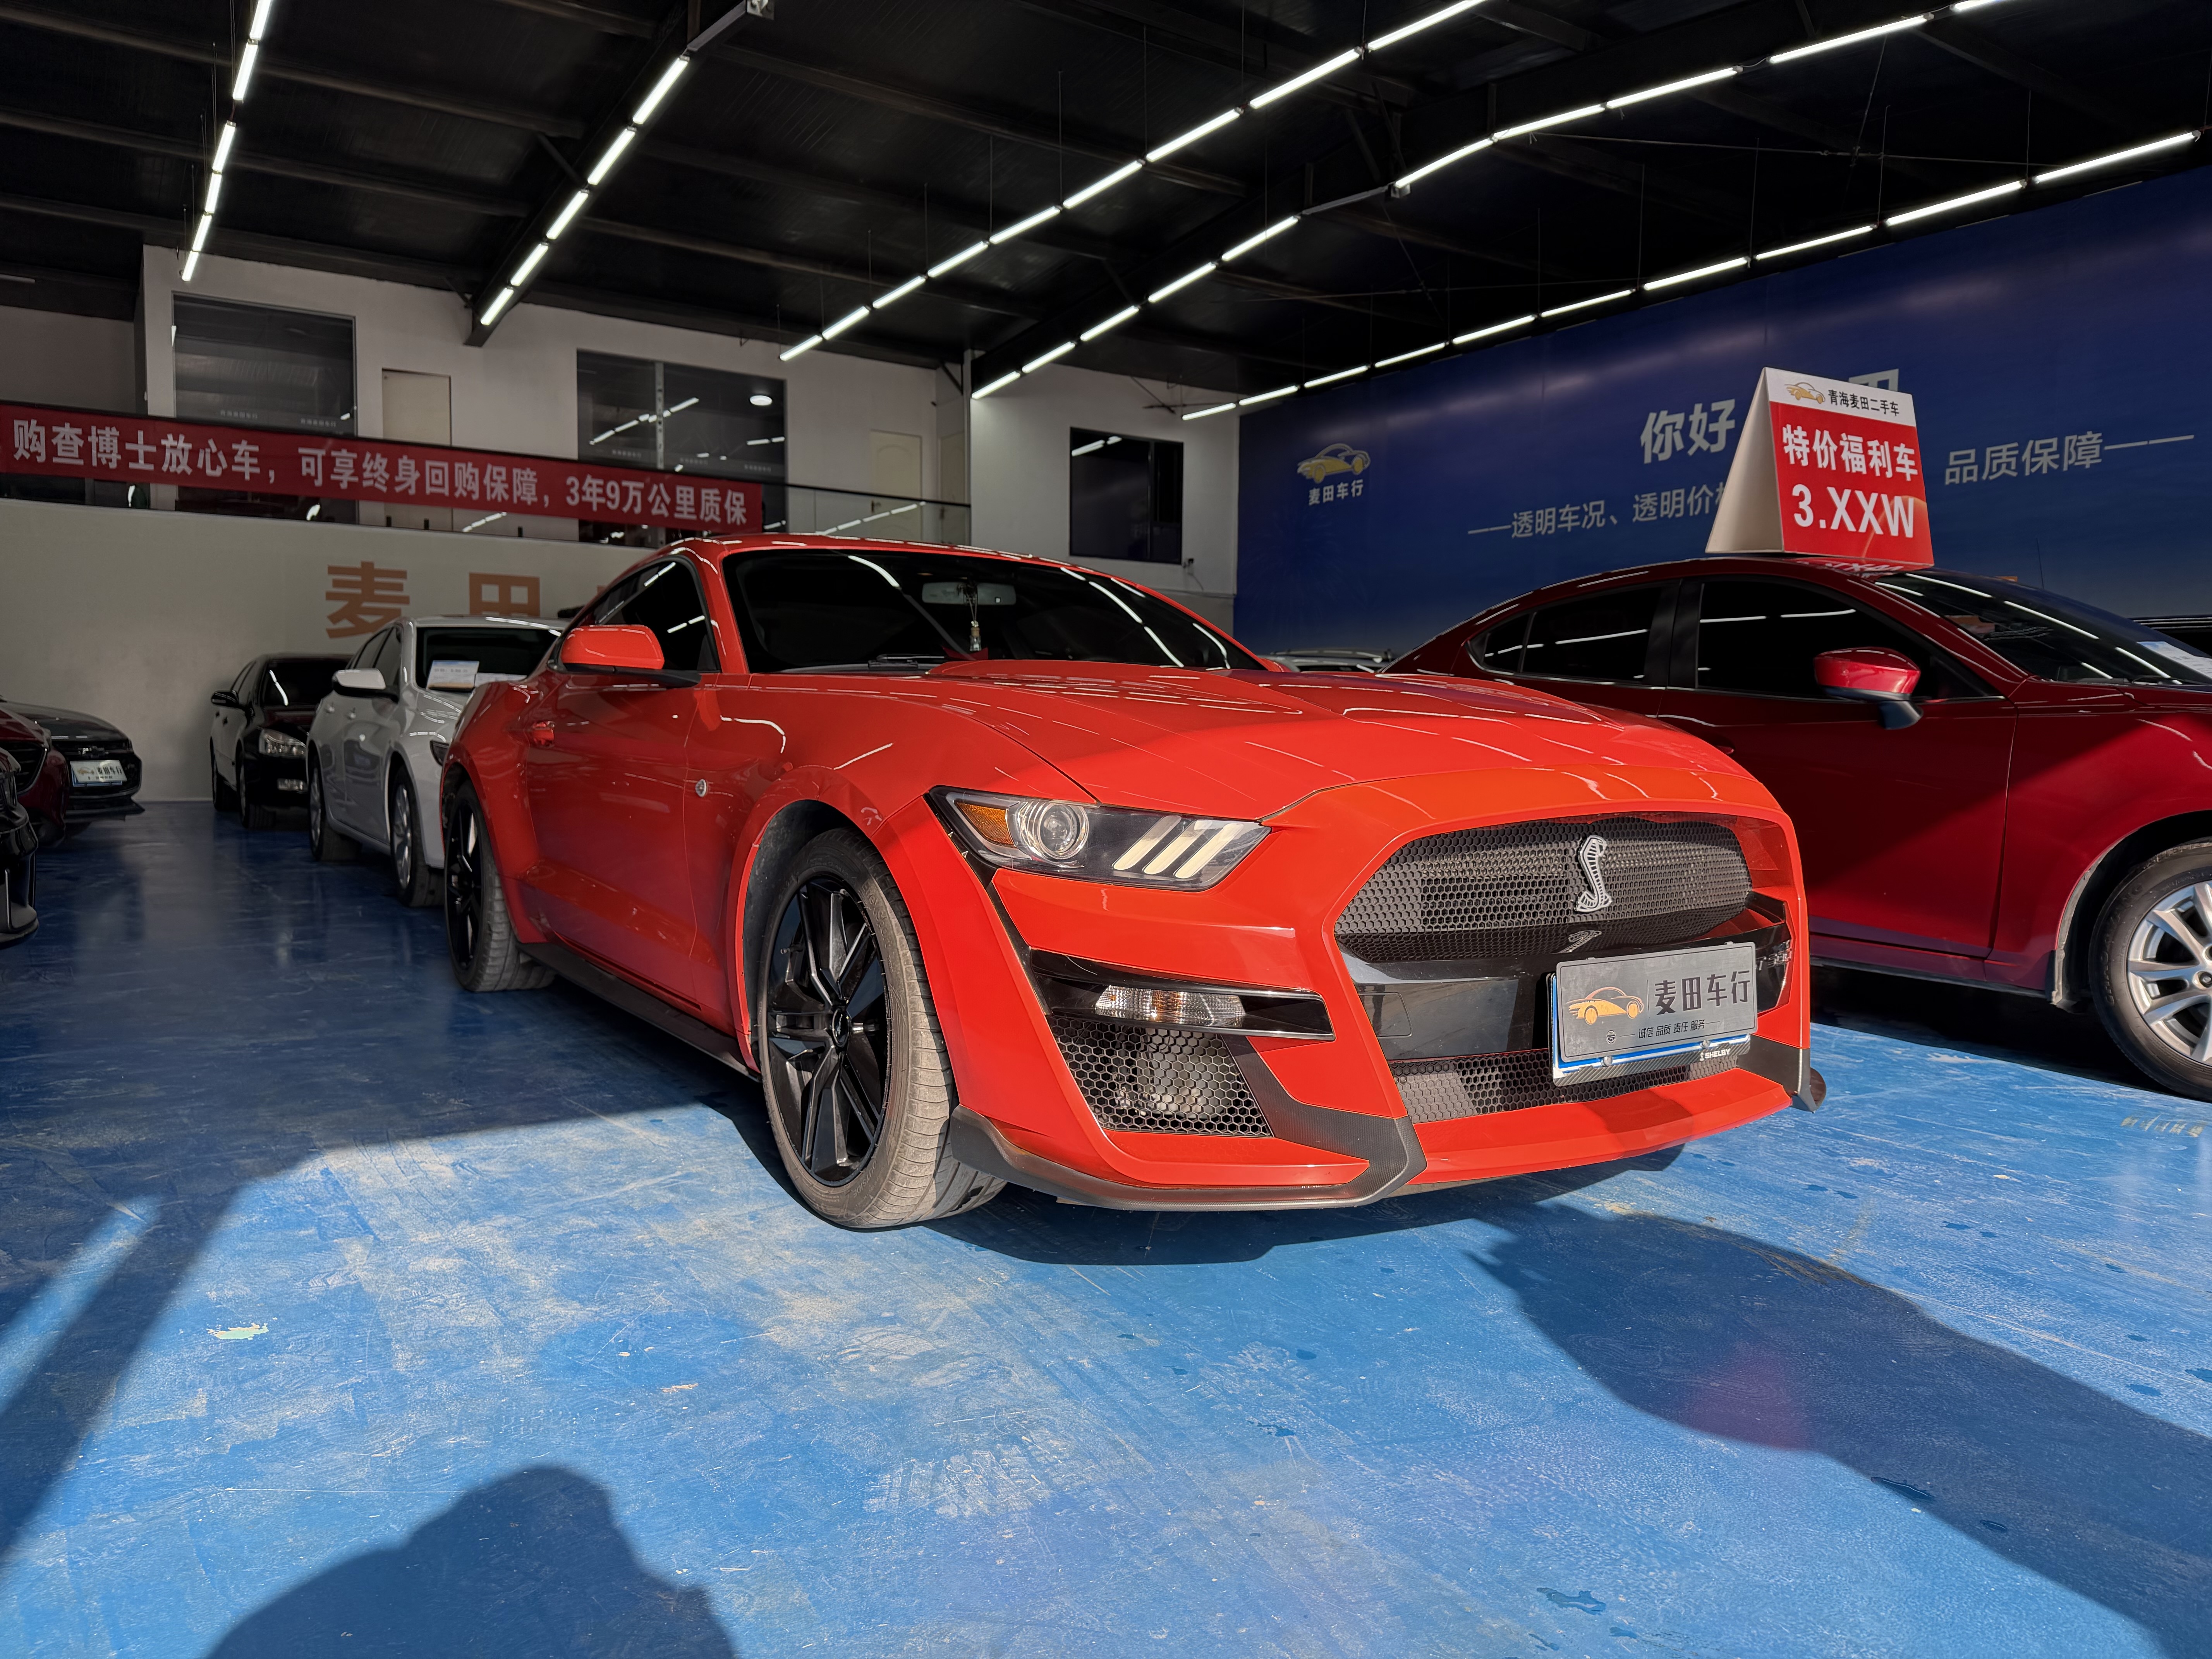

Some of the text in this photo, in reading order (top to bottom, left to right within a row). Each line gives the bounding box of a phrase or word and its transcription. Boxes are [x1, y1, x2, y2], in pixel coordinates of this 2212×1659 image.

[1828, 389, 1900, 416] 青海麦田二手车
[1783, 424, 1918, 481] 特价福利车
[1308, 479, 1364, 506] 麦田车行
[1792, 484, 1915, 538] 3.XXW
[325, 561, 613, 639] 麦田
[1654, 970, 1750, 1015] 麦田车行
[1638, 1019, 1705, 1039] 诚信 品质 责任 服务
[1705, 1048, 1730, 1059] SHELBY
